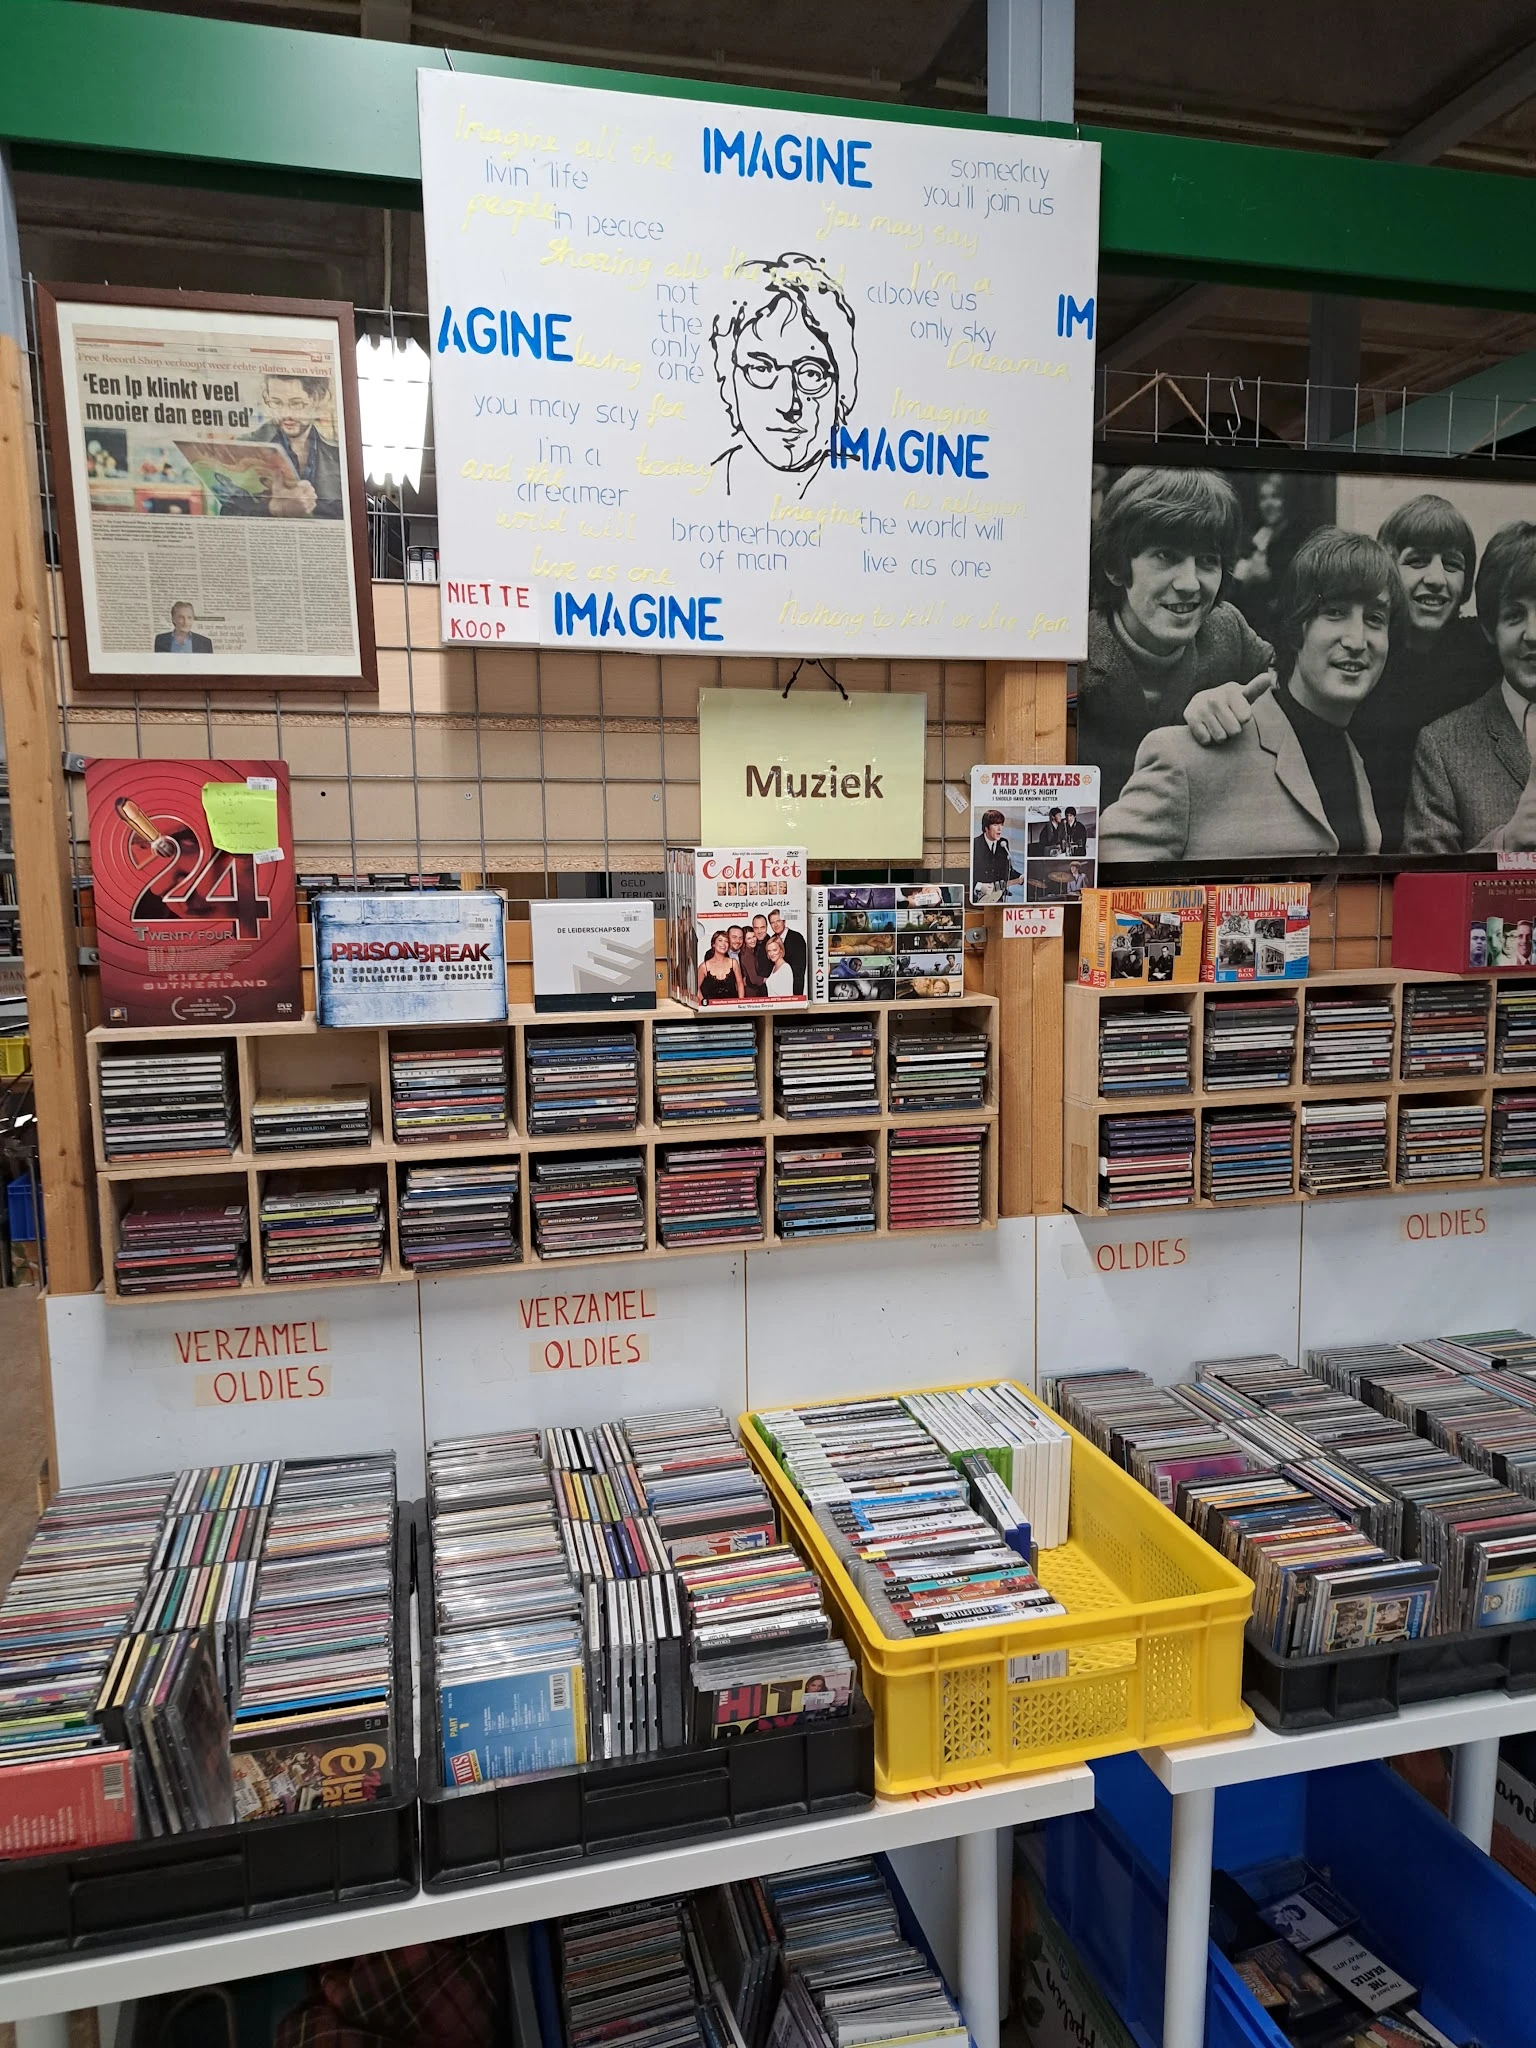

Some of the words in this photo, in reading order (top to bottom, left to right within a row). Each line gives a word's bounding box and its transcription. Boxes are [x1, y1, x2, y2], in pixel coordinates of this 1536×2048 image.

[703, 127, 873, 189] IMAGINE
[550, 160, 590, 190] life
[951, 158, 1050, 190] someday
[924, 184, 975, 210] you'll
[983, 188, 1021, 219] join
[1029, 197, 1055, 216] us
[553, 203, 573, 231] in
[586, 215, 665, 241] peace
[656, 281, 700, 306] not
[866, 281, 940, 308] above
[950, 290, 978, 312] us
[658, 308, 704, 336] the
[1057, 294, 1095, 341] IM
[437, 305, 574, 362] AGINE
[911, 319, 952, 347] only
[962, 320, 996, 352] sky
[651, 333, 701, 364] only
[658, 361, 704, 384] one
[125, 376, 142, 400] lp
[148, 377, 198, 400] klinkt
[203, 381, 240, 402] veel
[86, 402, 149, 423] mooier
[154, 404, 188, 425] dan
[192, 408, 224, 428] een
[474, 394, 518, 418] you
[529, 397, 581, 425] may
[596, 404, 639, 431] say
[585, 448, 602, 467] a
[829, 426, 991, 480] IMAGINE
[517, 481, 630, 507] dreamer
[672, 517, 822, 548] brotherhood
[858, 511, 898, 536] the
[906, 515, 967, 540] world
[975, 518, 1005, 542] will
[699, 550, 725, 574] of
[736, 551, 788, 571] man
[862, 550, 898, 574] live
[910, 558, 937, 577] as
[950, 559, 992, 579] one
[447, 581, 492, 607] NIET
[498, 587, 531, 609] TE
[450, 617, 507, 640] KOOP
[554, 591, 724, 642] IMAGINE
[745, 764, 884, 799] Muziek
[992, 772, 1019, 787] THE
[1022, 772, 1081, 787] BEATLES
[992, 788, 997, 796] A
[999, 788, 1017, 796] HARD
[1038, 788, 1058, 796] NIGHT
[128, 814, 271, 941] 24
[702, 857, 757, 880] Cold
[620, 879, 646, 888] GELD
[724, 900, 758, 910] complete
[1005, 909, 1034, 923] NIET
[1039, 908, 1056, 920] TE
[1181, 915, 1201, 923] BOX
[567, 926, 631, 934] LEIDERSCHAPSBOX
[815, 917, 825, 967] arthouse
[1014, 924, 1047, 937] KOOP
[143, 980, 268, 991] SUTHERLAND
[168, 972, 234, 982] KIEFER
[815, 976, 825, 1000] nrc
[1406, 1208, 1486, 1240] OLDIES
[1096, 1238, 1187, 1272] OLDIES
[520, 1289, 656, 1329] VERZAMEL
[174, 1321, 328, 1364] VERZAMEL
[544, 1334, 641, 1370] OLDIES
[213, 1366, 325, 1404] OLDIES
[717, 1680, 803, 1725] HIT
[719, 1690, 729, 1707] THE
[449, 1717, 458, 1738] PART
[1350, 1965, 1387, 1987] BEATLES
[1367, 1978, 1388, 1991] THE
